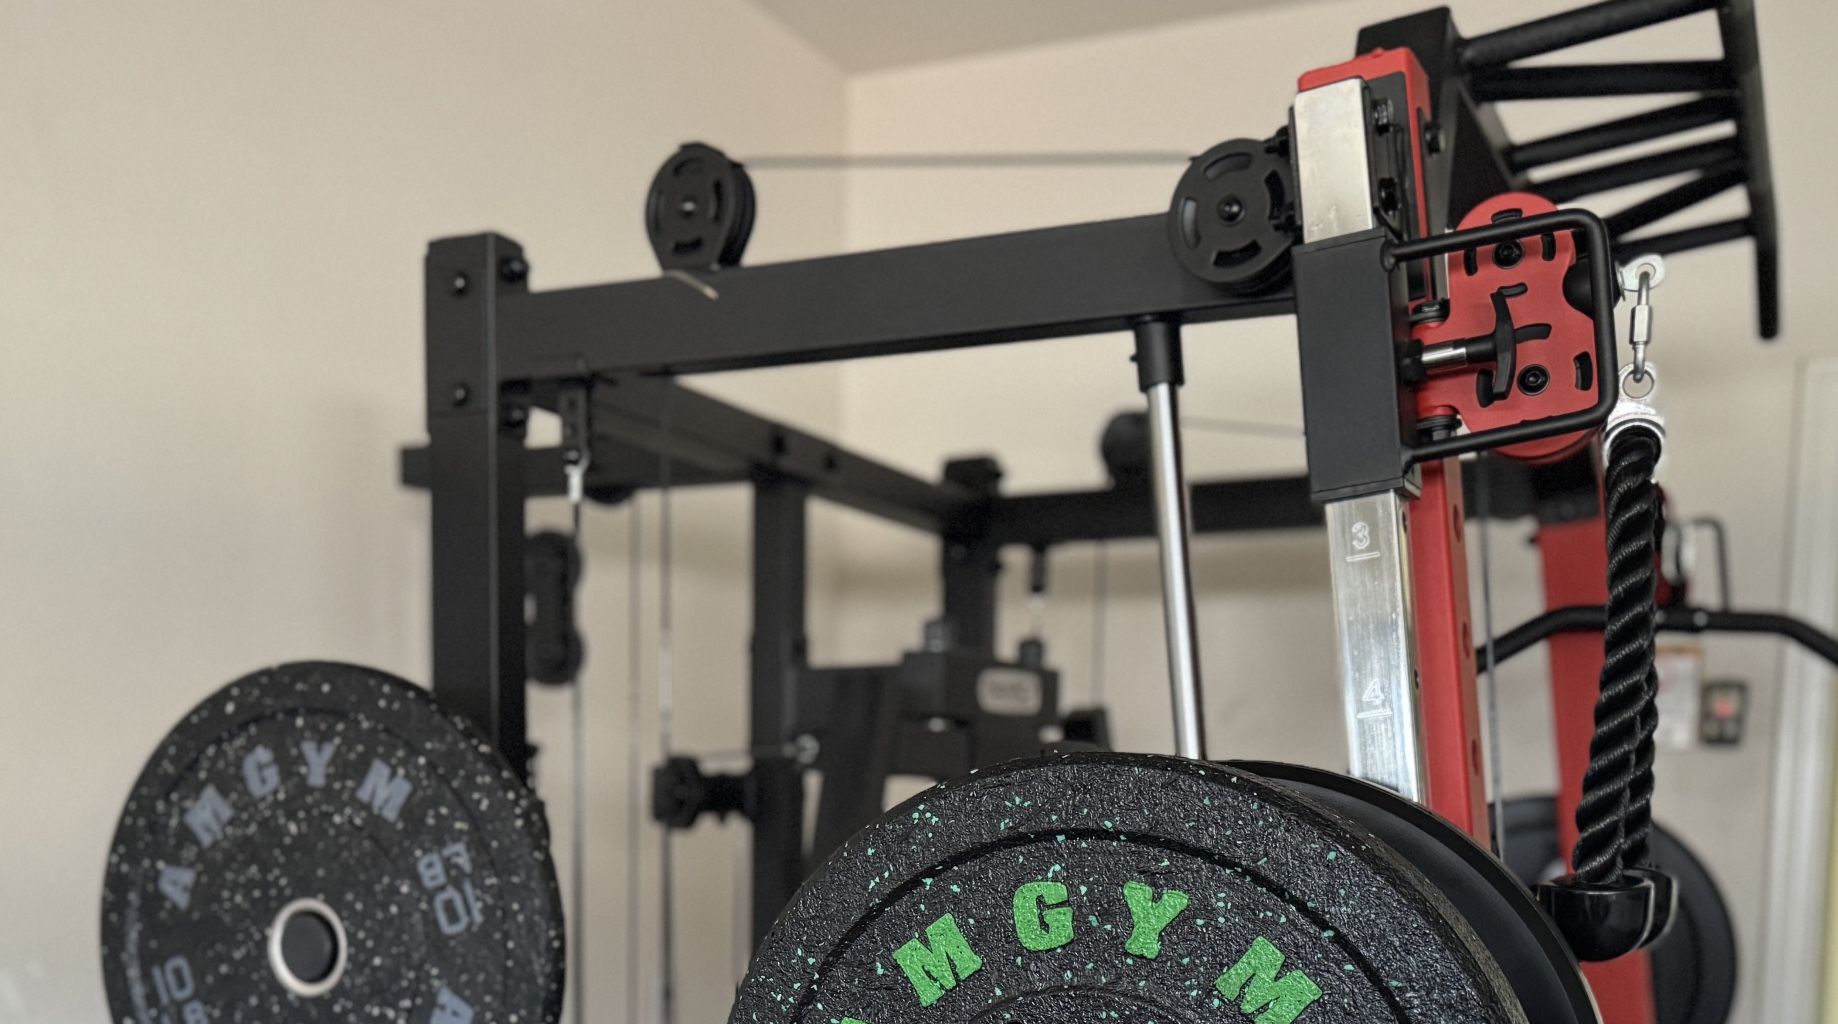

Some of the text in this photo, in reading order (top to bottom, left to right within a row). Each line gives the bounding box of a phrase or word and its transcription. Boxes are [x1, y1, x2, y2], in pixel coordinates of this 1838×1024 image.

[1352, 522, 1370, 549] 3
[1363, 678, 1385, 705] 4
[417, 841, 472, 889] LB
[434, 881, 483, 935] 10
[153, 955, 194, 1001] 10
